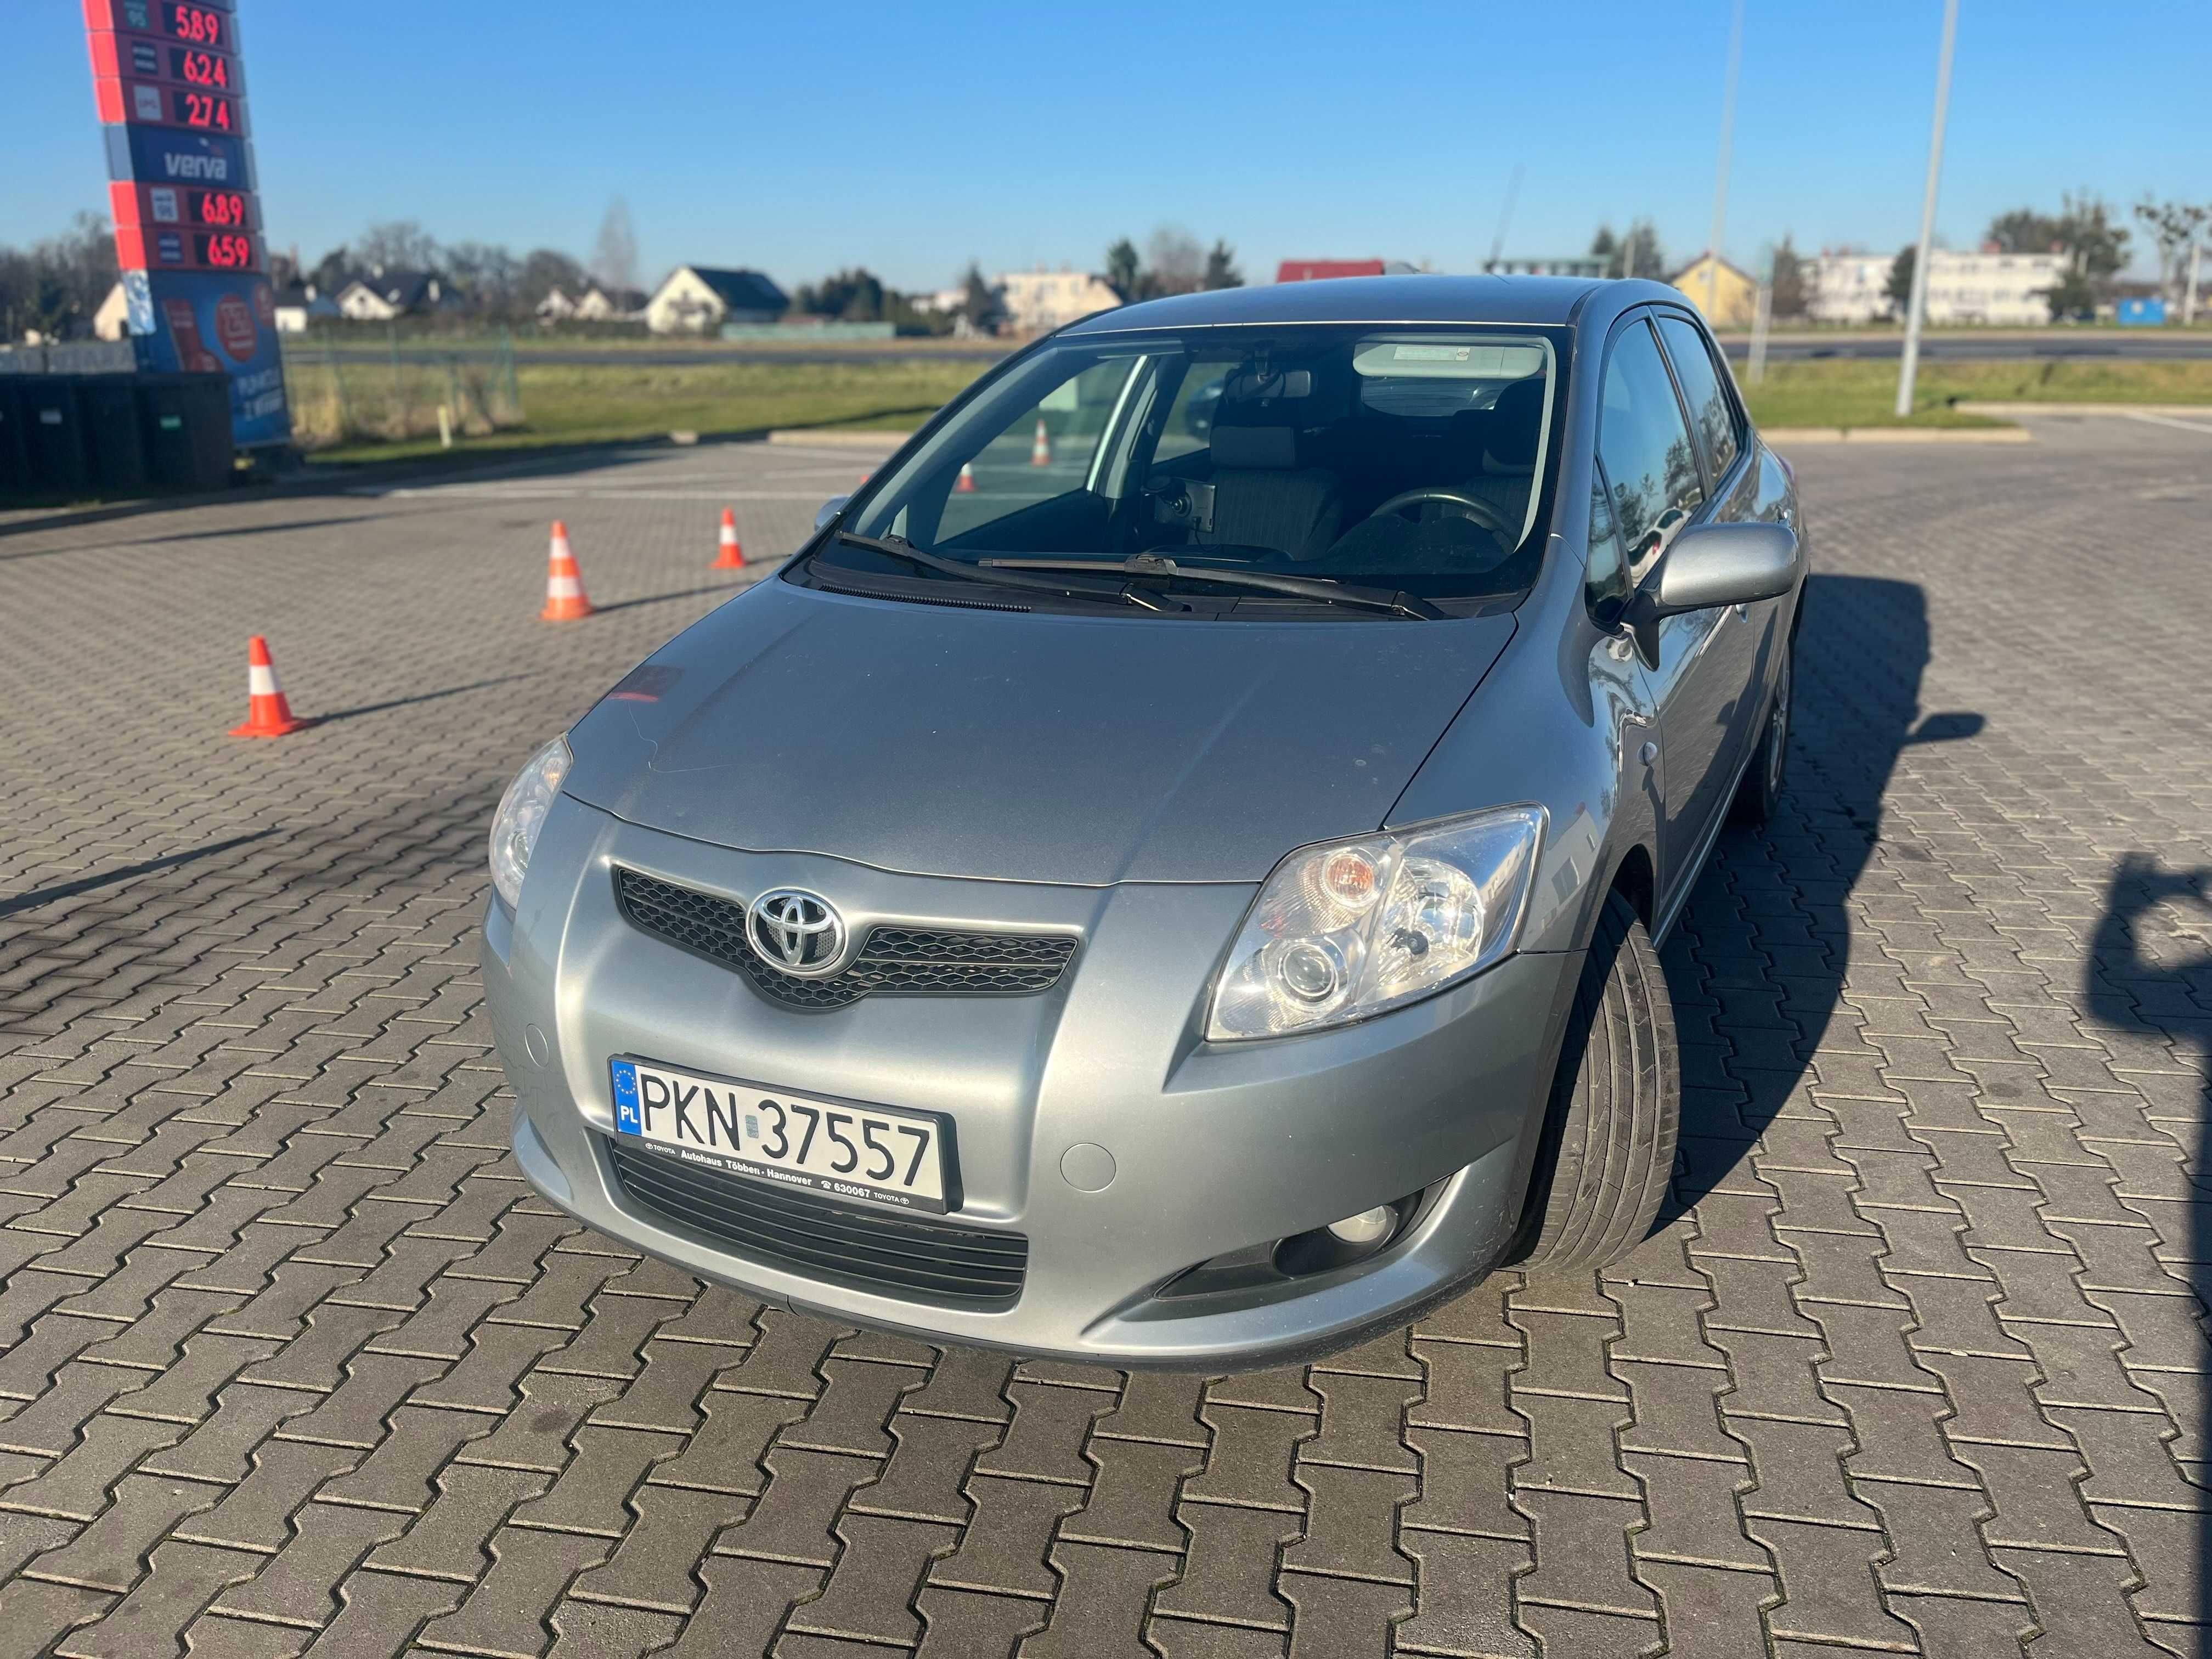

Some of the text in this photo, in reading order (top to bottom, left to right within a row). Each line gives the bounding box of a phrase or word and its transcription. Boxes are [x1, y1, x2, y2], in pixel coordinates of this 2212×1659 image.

[164, 151, 228, 180] verva
[620, 1105, 638, 1124] PL
[640, 1073, 930, 1186] PKN 37557
[652, 1144, 676, 1155] TOYOTA
[680, 1149, 723, 1167] Autohaus
[766, 1168, 812, 1186] Hannover
[834, 1182, 871, 1198] 630067
[873, 1192, 900, 1203] TOYOTA
